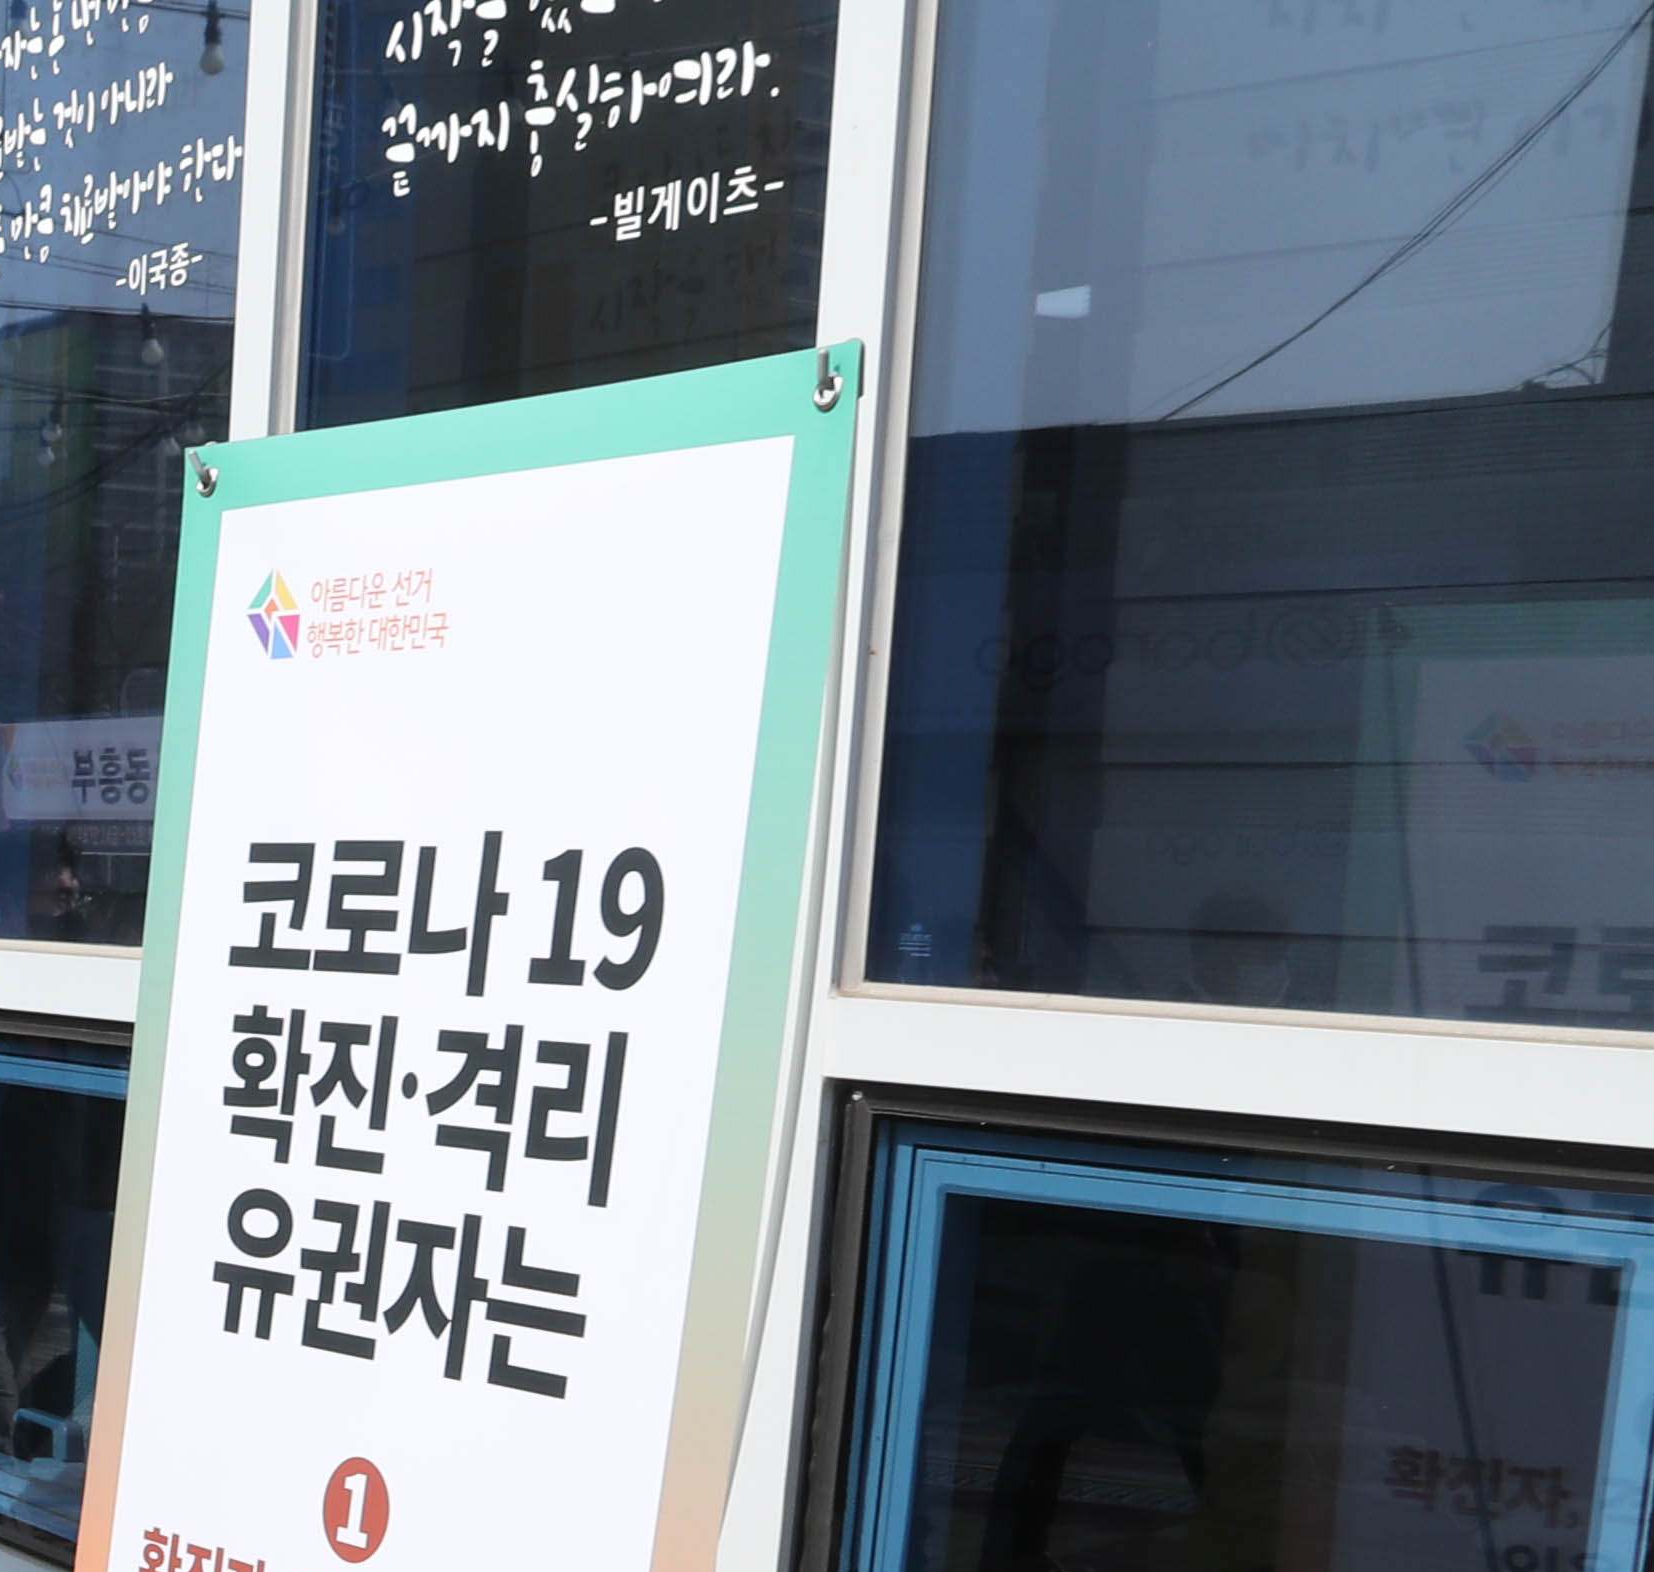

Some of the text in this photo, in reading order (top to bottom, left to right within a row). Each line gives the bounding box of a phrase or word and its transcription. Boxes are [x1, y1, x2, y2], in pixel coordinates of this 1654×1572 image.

[53, 90, 94, 148] 것이
[101, 62, 174, 125] 아니라
[381, 101, 510, 198] 끝까지
[11, 184, 53, 263] 만큼
[60, 161, 173, 244] 치료받아야
[179, 135, 243, 202] 한다
[590, 165, 784, 241] -빌게이츠-
[115, 242, 203, 295] -이국종-
[311, 568, 433, 613] 아름다운 선거
[306, 611, 449, 659] 행복한 대한민국
[72, 746, 152, 806] 부흥동
[228, 830, 665, 998] 코로나 19
[223, 1004, 629, 1208] 확진·격리
[212, 1187, 587, 1400] 유권자는
